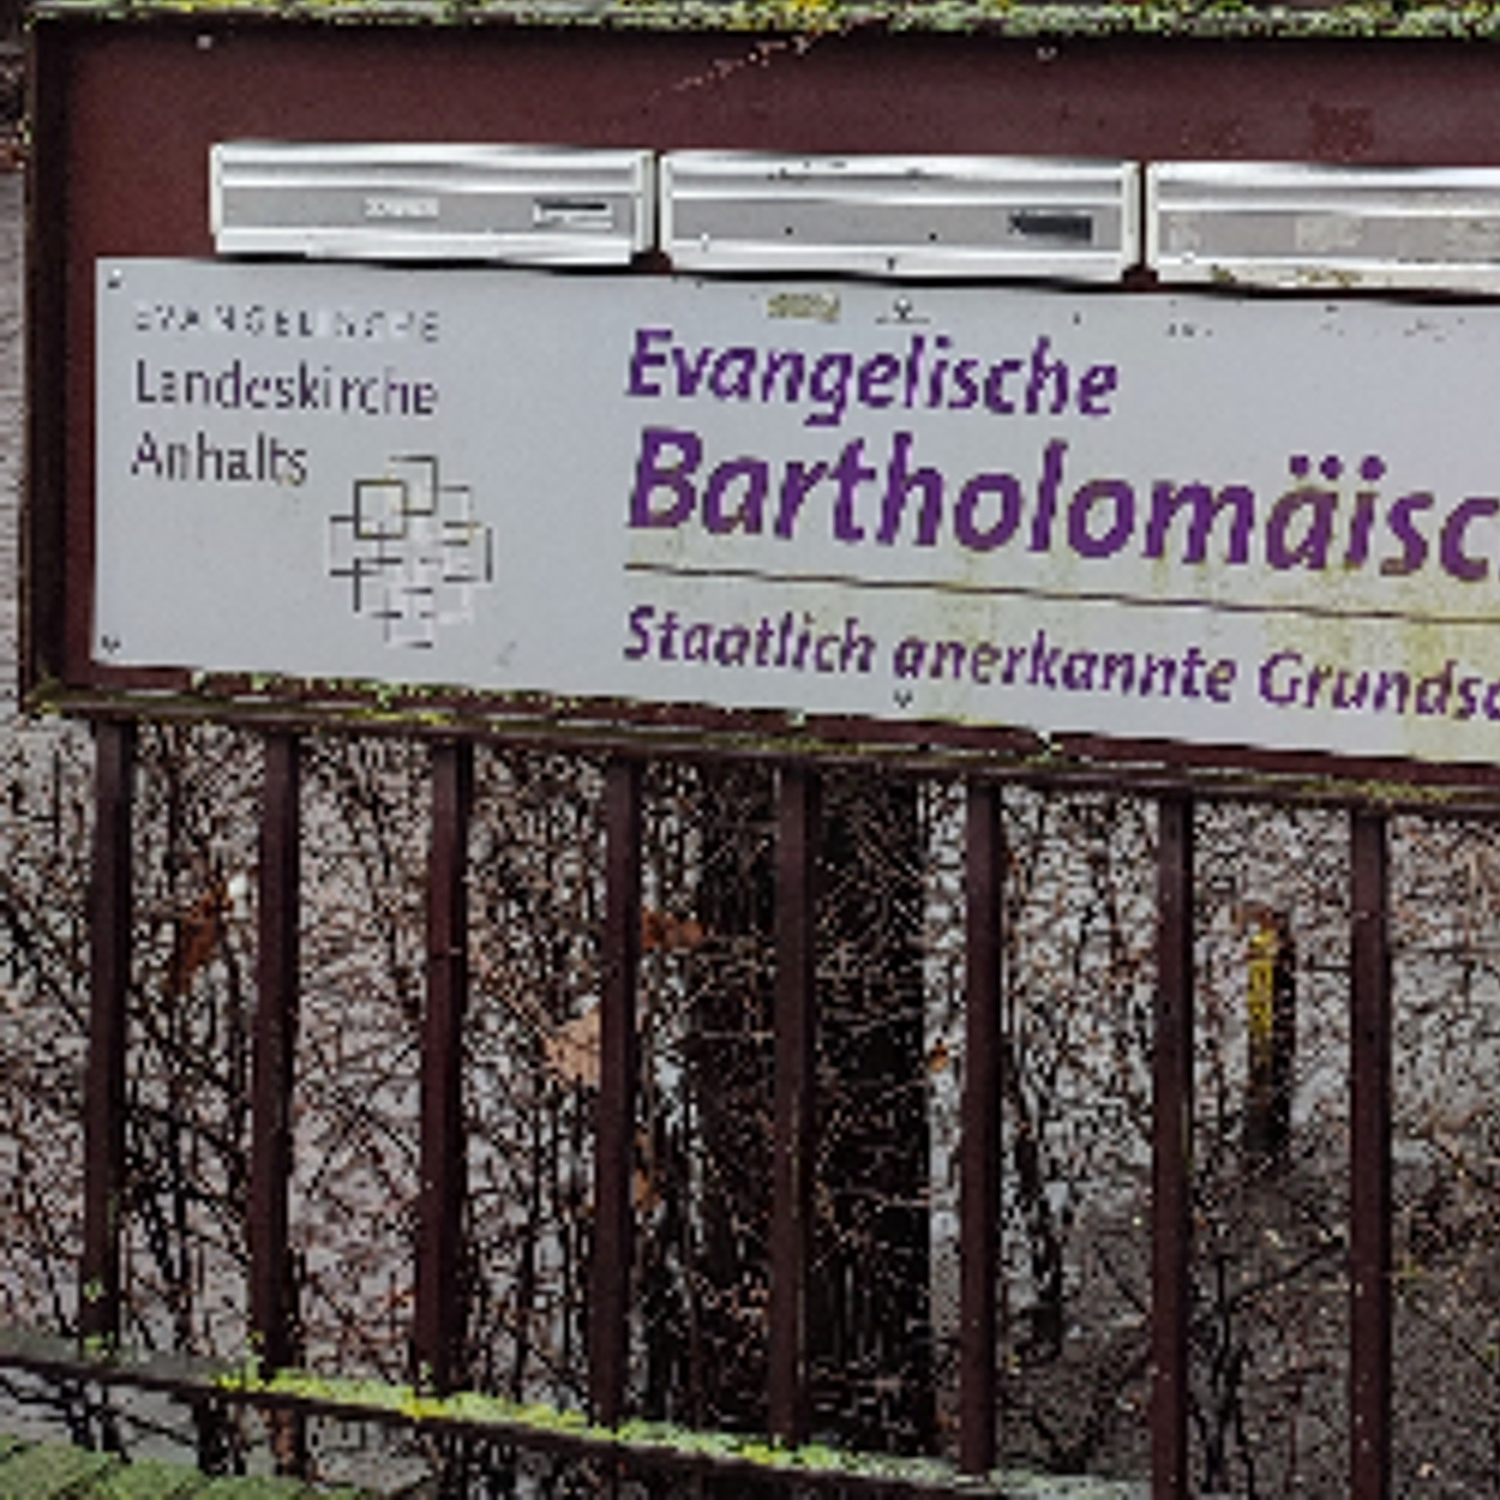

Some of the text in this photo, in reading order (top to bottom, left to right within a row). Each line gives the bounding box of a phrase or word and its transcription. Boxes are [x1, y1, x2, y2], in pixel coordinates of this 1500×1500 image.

[135, 304, 439, 344] EVANGELSCHE
[136, 359, 438, 416] Landeskirche
[624, 327, 1119, 427] Evangelische
[131, 430, 308, 487] Anhalts
[622, 604, 877, 674] Staatlich
[892, 628, 1238, 705] anerkannte
